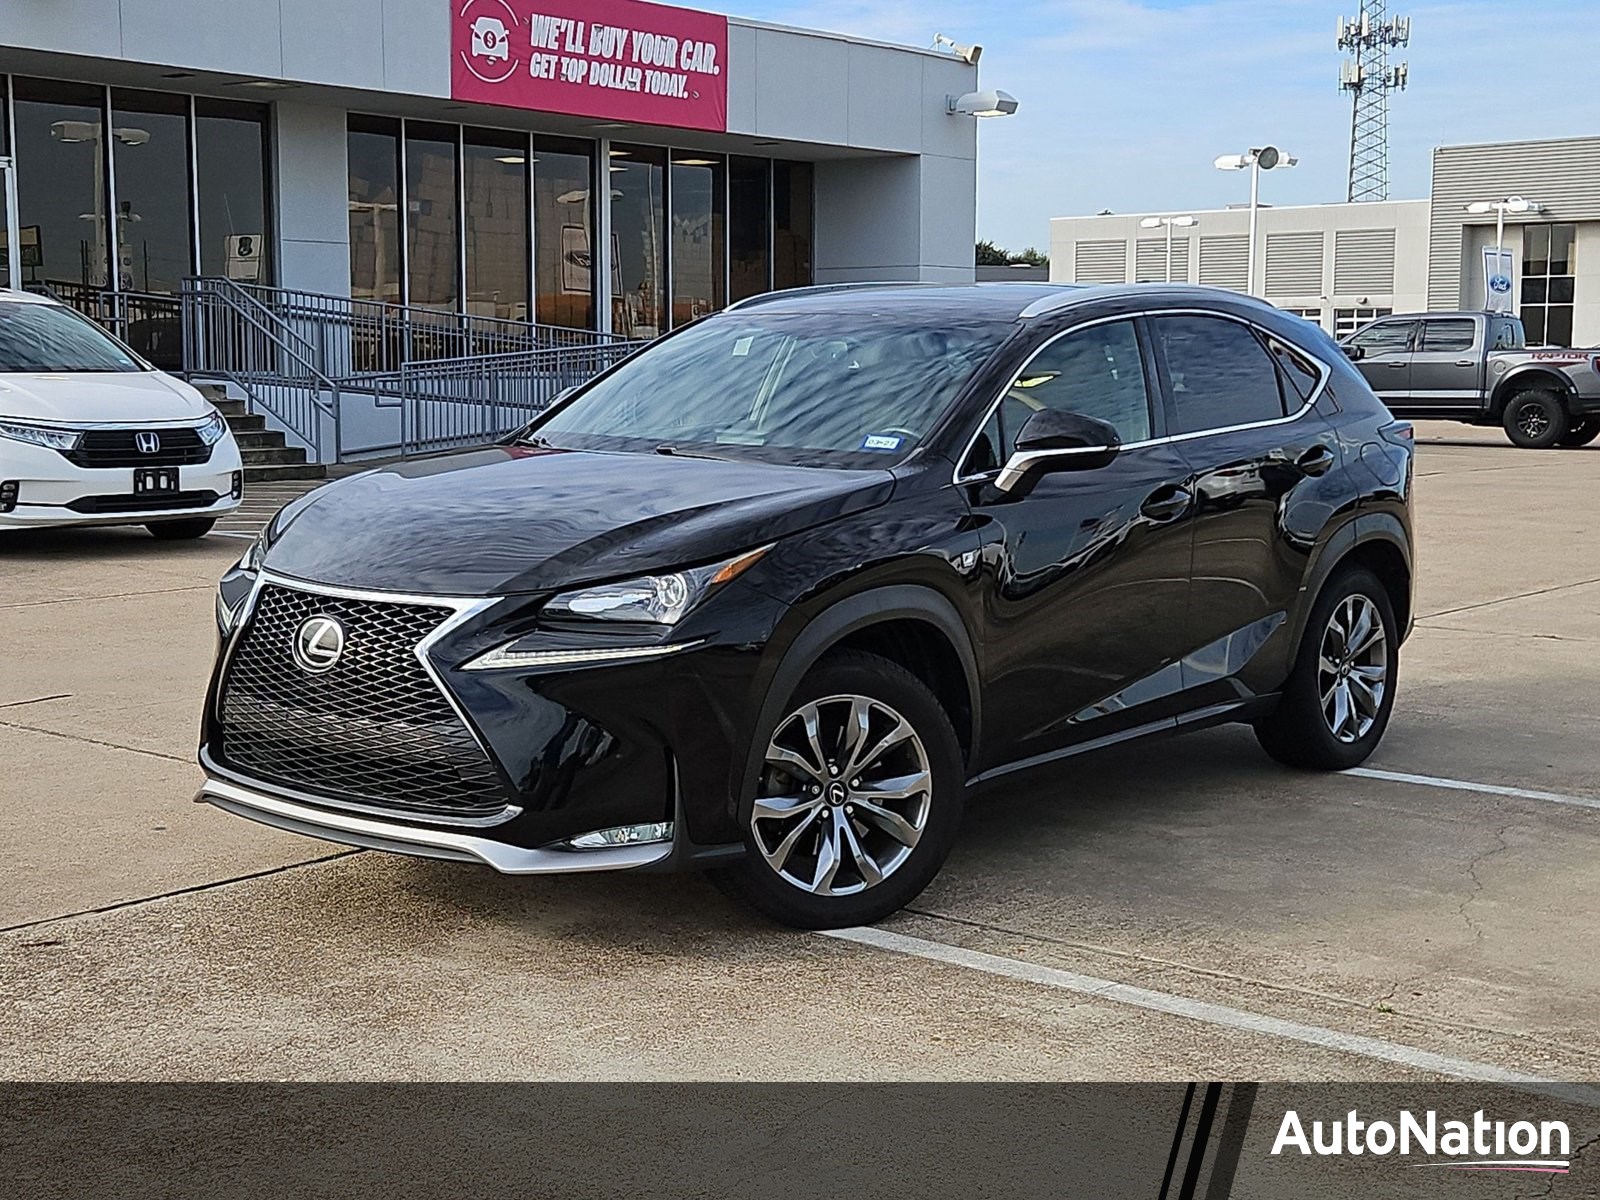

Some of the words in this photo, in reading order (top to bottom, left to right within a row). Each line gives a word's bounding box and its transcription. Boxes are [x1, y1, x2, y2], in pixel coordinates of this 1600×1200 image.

[531, 13, 585, 54] WE'LL
[588, 23, 629, 60] BUY
[632, 30, 678, 68] YOUR
[680, 40, 720, 75] CAR.
[530, 52, 558, 79] GET
[561, 57, 588, 84] TOP
[589, 61, 642, 92] DOLLAR
[645, 69, 688, 99] TODAY.
[1531, 352, 1589, 361] RAPTOR
